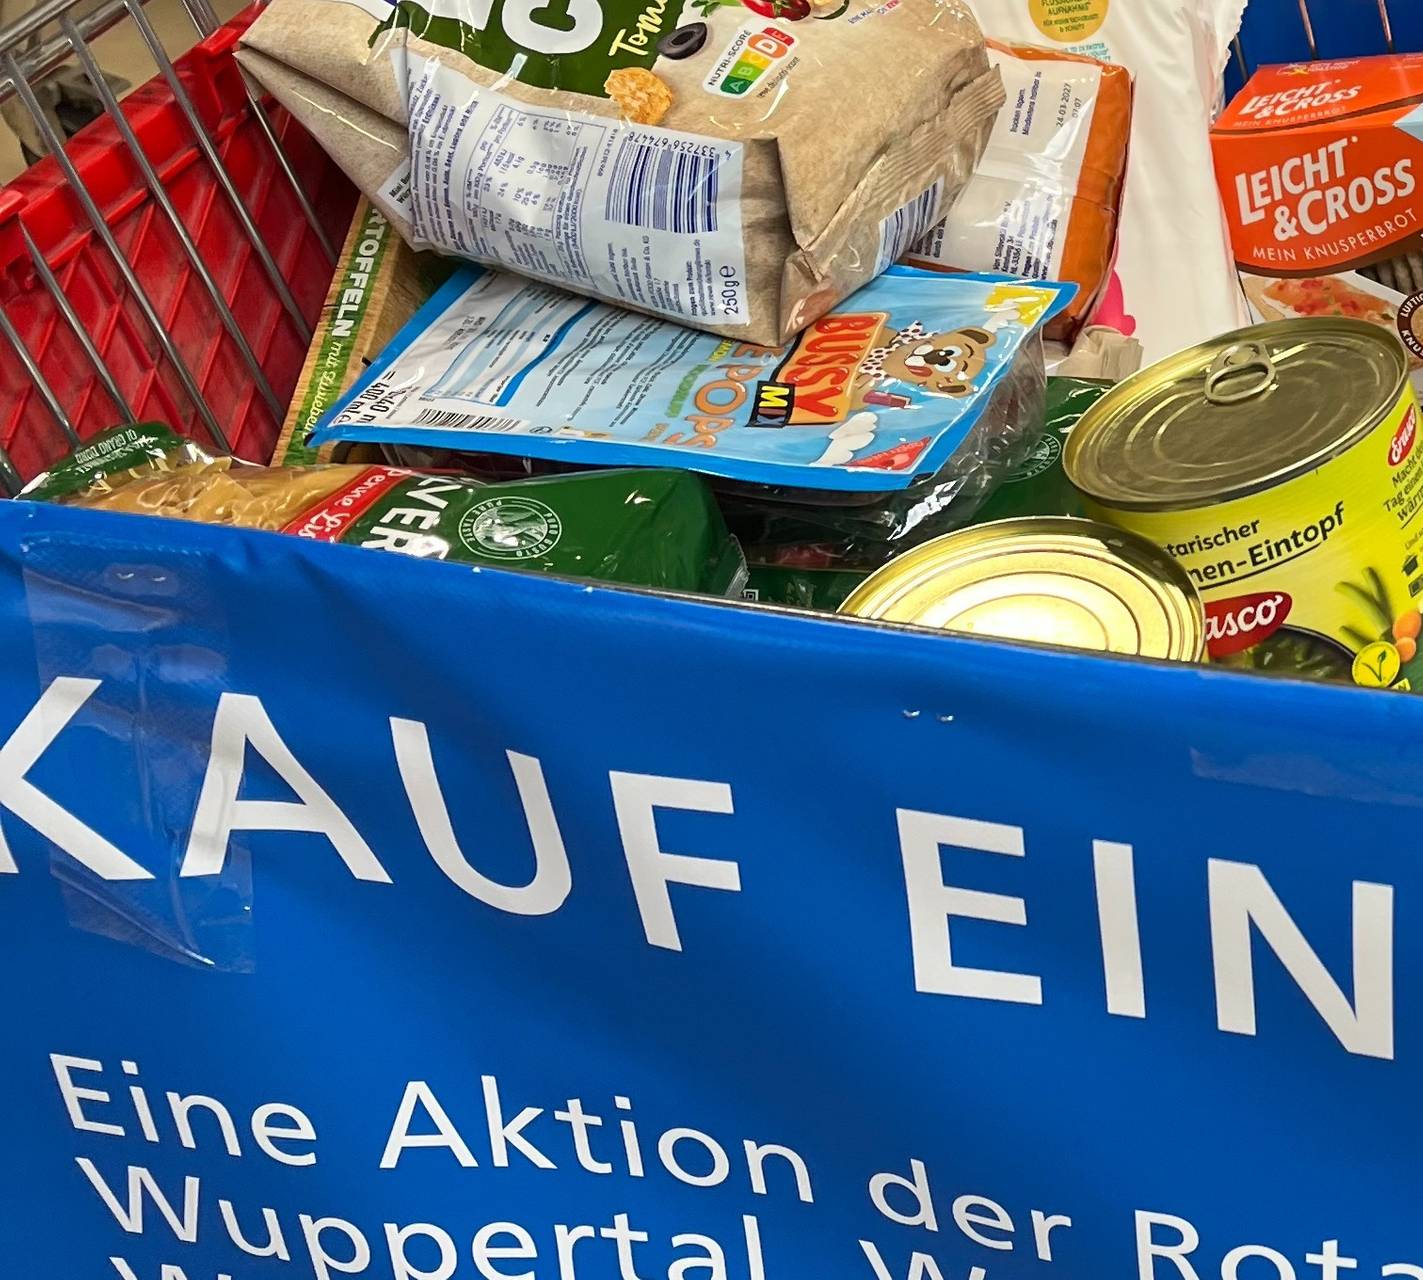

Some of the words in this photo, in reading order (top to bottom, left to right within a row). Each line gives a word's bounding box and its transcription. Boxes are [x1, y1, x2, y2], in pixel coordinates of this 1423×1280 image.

[708, 29, 752, 86] NUTRI-SCORE
[755, 39, 777, 55] D
[1239, 80, 1332, 115] LEICHT
[627, 131, 668, 147] 674478
[674, 140, 716, 158] 337256
[1235, 137, 1348, 226] LEICHT
[1252, 245, 1297, 262] MEIN
[1304, 207, 1417, 261] KNUSPERBROT
[323, 343, 342, 370] mit
[793, 317, 875, 419] BUSSY
[98, 433, 127, 455] GRANO
[473, 499, 503, 516] PURE
[1383, 491, 1406, 512] Tag
[462, 518, 475, 543] TASTE
[543, 511, 558, 536] PURO
[515, 536, 555, 558] GUSTO
[0, 676, 741, 951] KAUF
[49, 1053, 317, 1167] Eine
[379, 1075, 815, 1204] Aktion
[868, 1158, 1072, 1263] der
